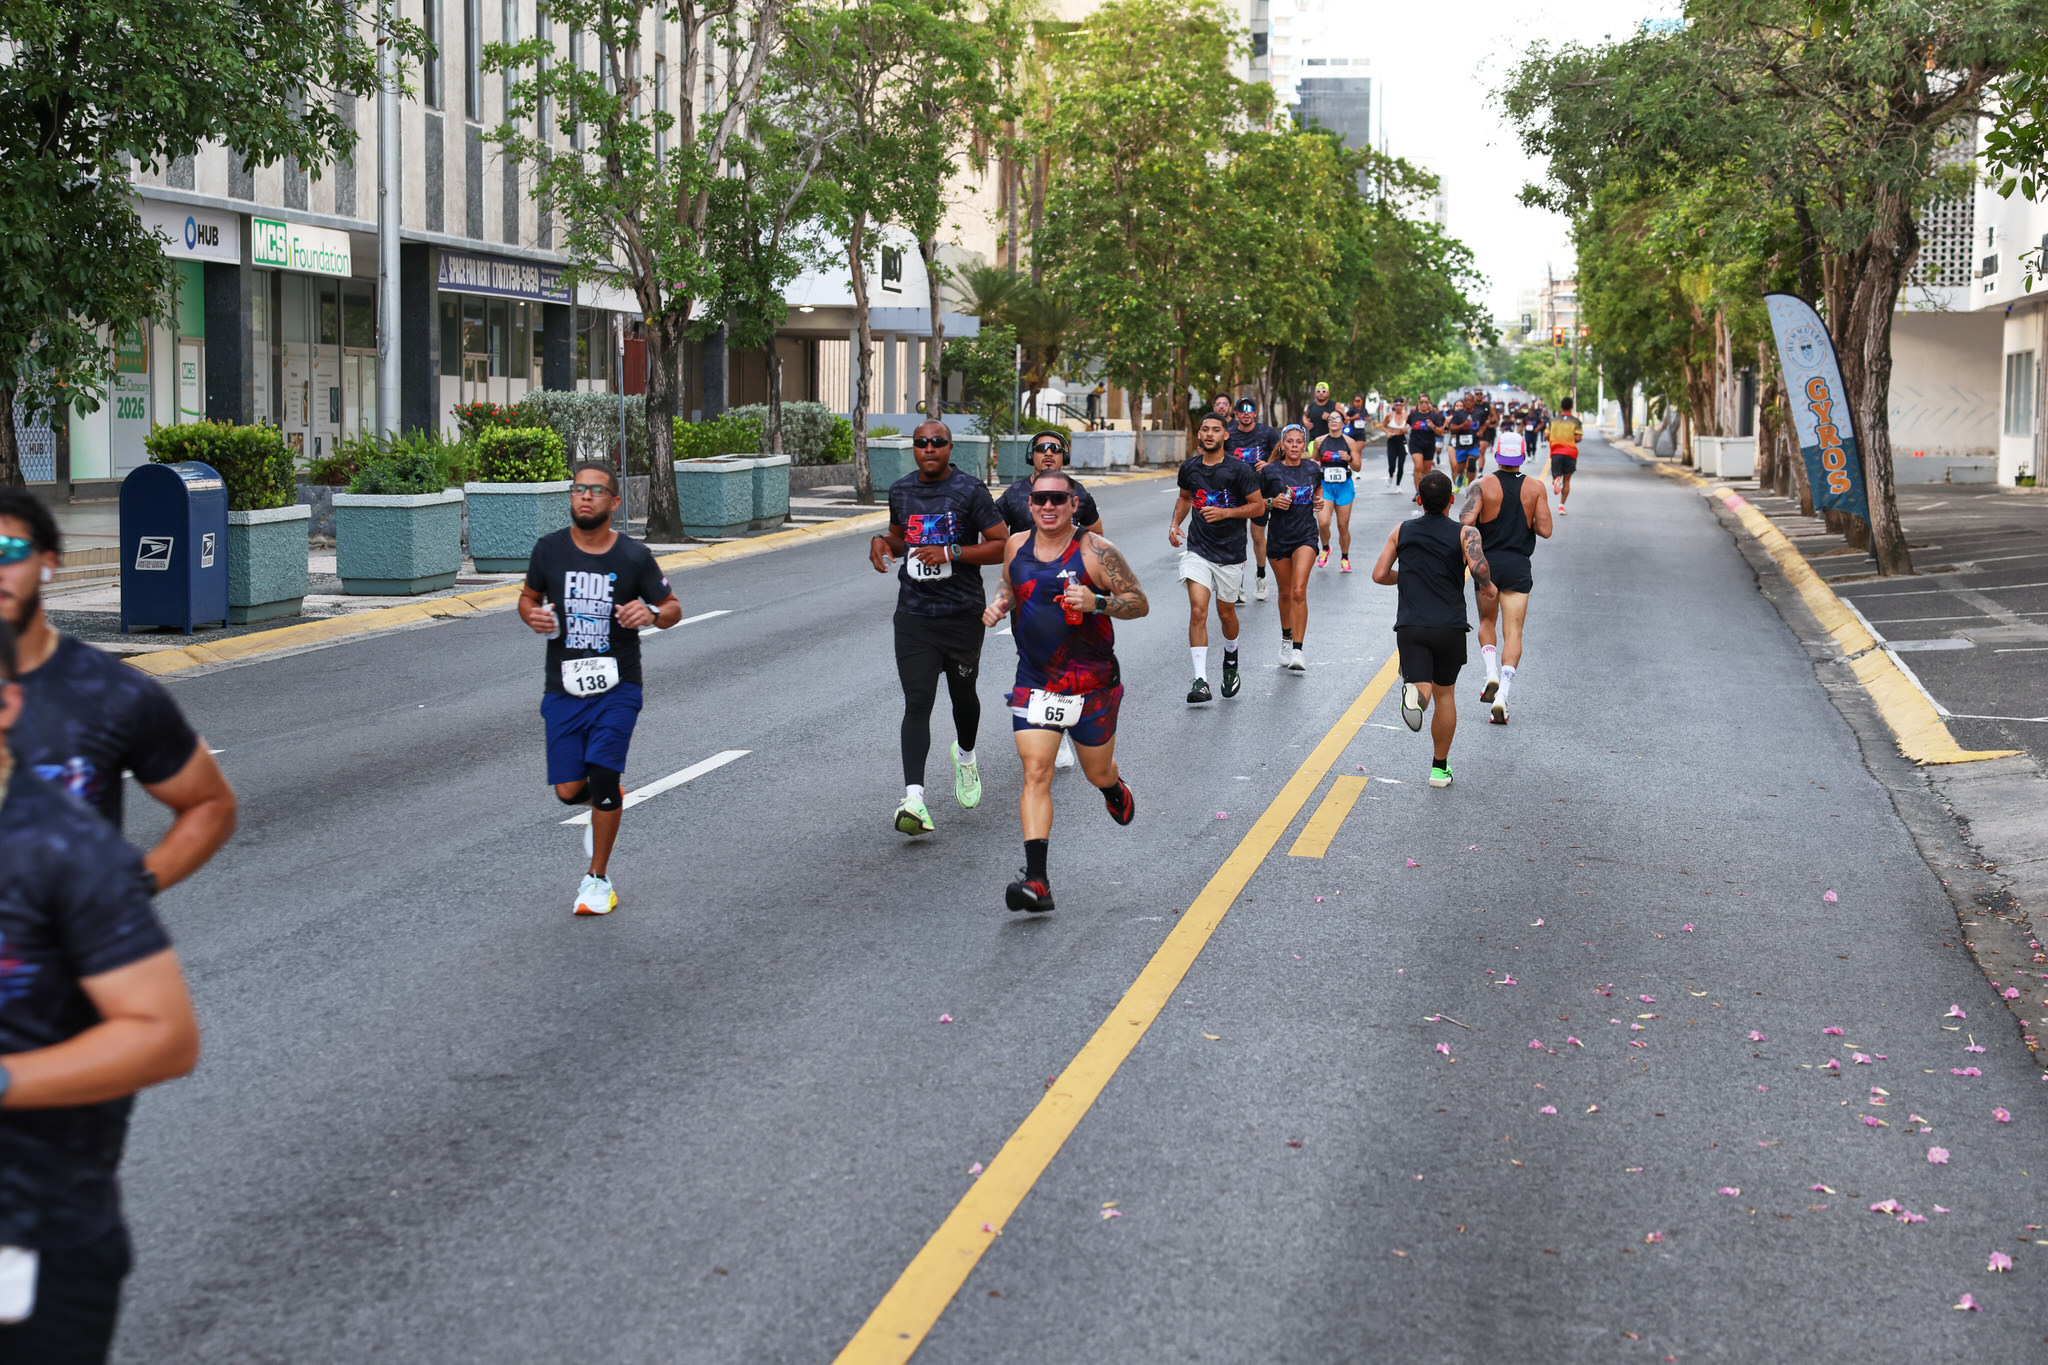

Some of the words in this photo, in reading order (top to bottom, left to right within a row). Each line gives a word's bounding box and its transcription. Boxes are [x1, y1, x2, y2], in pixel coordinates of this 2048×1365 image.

[197, 223, 219, 247] HUB
[254, 221, 286, 263] MCS
[293, 236, 350, 274] Foundation
[448, 255, 466, 285] SPACE
[466, 258, 477, 287] FOR
[477, 260, 491, 288] RENT
[117, 396, 145, 419] 2026
[1807, 376, 1851, 494] GYROS
[29, 443, 44, 455] HUB
[1195, 488, 1222, 505] 5K
[907, 514, 945, 536] 5K
[916, 563, 942, 577] 163
[564, 571, 615, 603] FADE
[564, 599, 613, 617] PRIMERO
[566, 616, 610, 636] CARDIO
[576, 675, 608, 692] 138
[1045, 706, 1065, 722] 65
